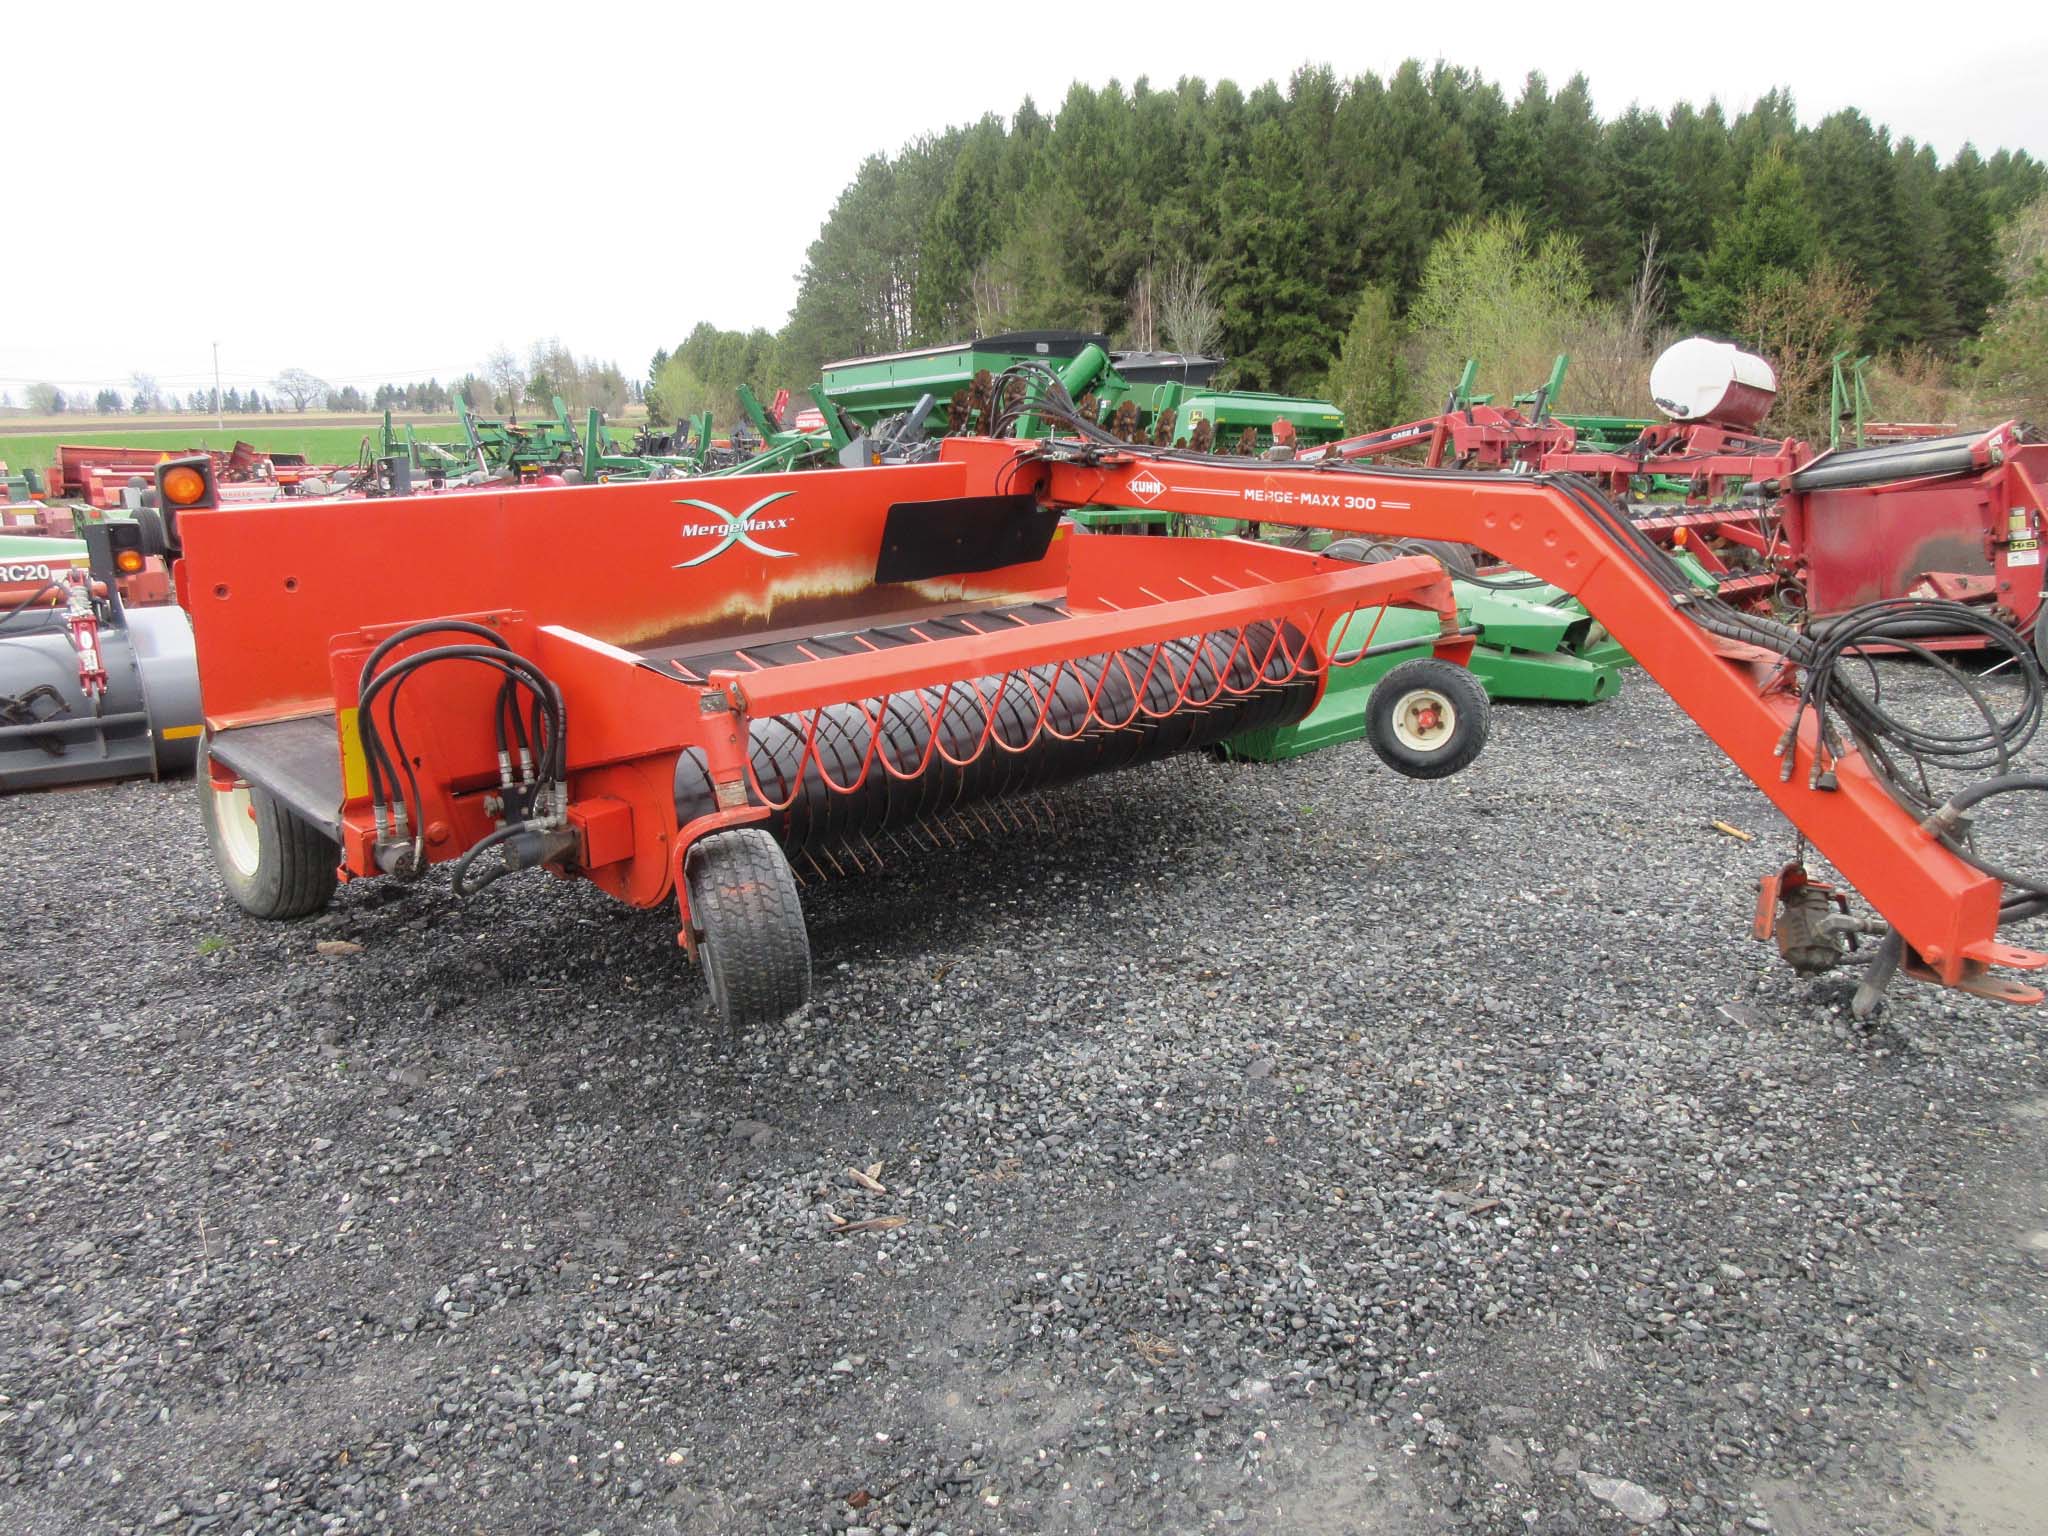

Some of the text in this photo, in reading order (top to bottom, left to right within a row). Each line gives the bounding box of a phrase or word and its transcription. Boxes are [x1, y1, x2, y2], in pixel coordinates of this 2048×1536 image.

[1131, 481, 1162, 494] KUHN
[1244, 488, 1376, 511] MERGE-MAXX 300
